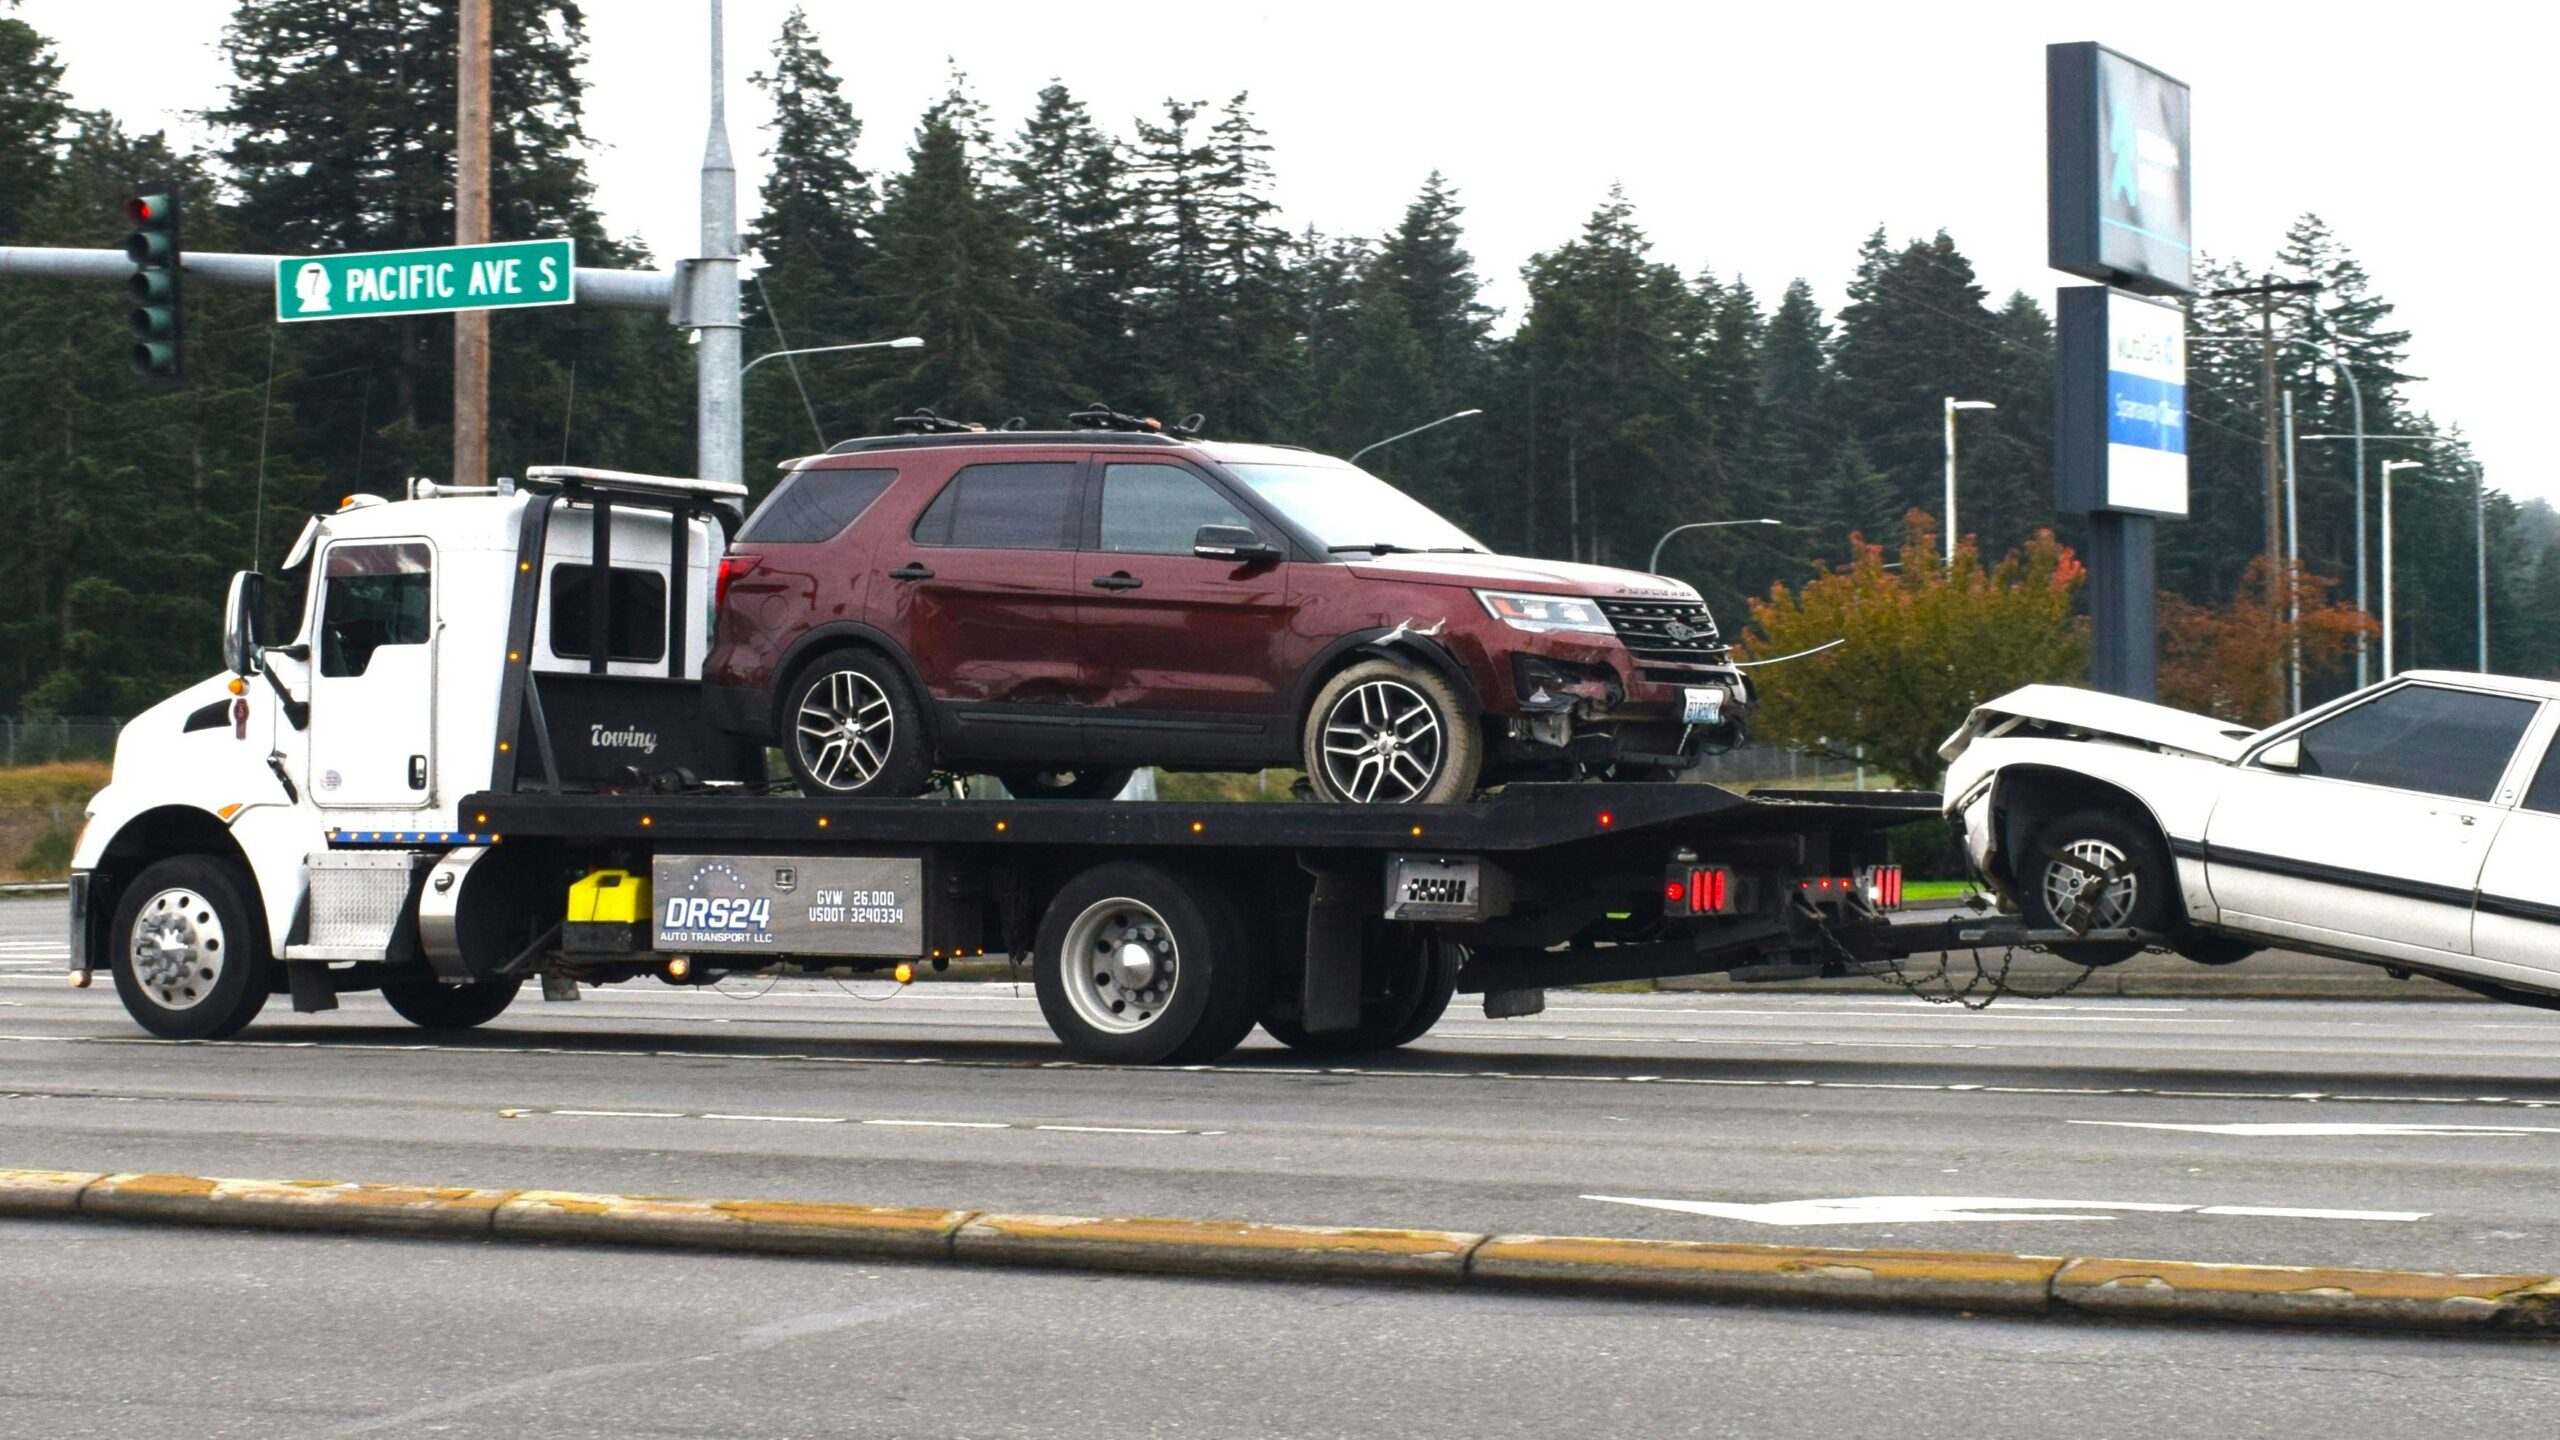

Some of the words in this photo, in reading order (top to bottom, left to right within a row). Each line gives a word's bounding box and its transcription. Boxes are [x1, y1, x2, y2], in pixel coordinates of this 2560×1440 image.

[307, 268, 321, 296] 7
[346, 262, 455, 303] PACIFIC
[468, 258, 522, 296] AVE
[538, 256, 558, 292] S
[590, 724, 658, 755] Towing
[816, 890, 844, 905] GVW
[664, 897, 771, 930] DRS24
[808, 906, 846, 922] USDOT
[850, 907, 904, 923] 3240334
[660, 931, 688, 942] AUTO
[691, 932, 751, 943] TRANSPORT
[754, 933, 773, 943] LLC
